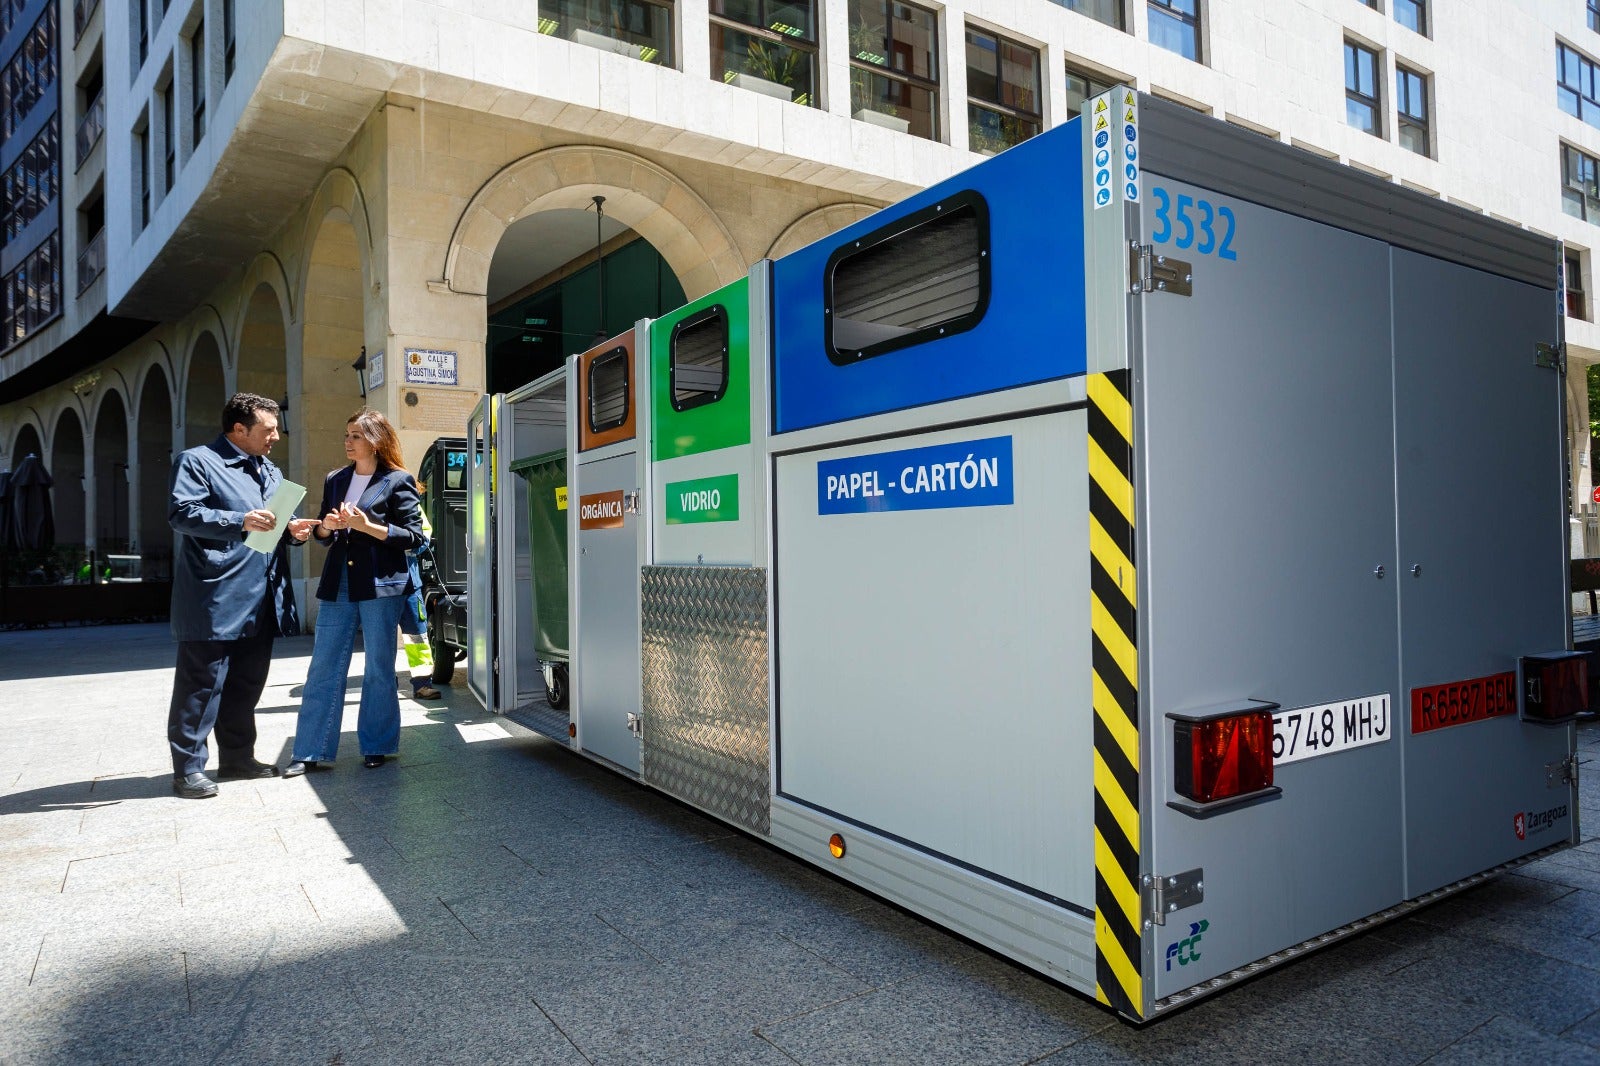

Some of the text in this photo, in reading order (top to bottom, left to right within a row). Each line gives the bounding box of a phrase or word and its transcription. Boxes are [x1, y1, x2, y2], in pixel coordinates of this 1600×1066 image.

[1152, 187, 1237, 261] 3532
[427, 355, 448, 363] CALLE
[408, 367, 437, 378] AGUSTINA
[827, 471, 884, 500] PAPEL
[900, 453, 998, 494] CARTÓN
[581, 500, 622, 520] ORGÁNICA
[680, 489, 720, 512] VIDRIO
[1272, 698, 1387, 758] 5748 MHJ
[1527, 804, 1567, 828] Zaragoza
